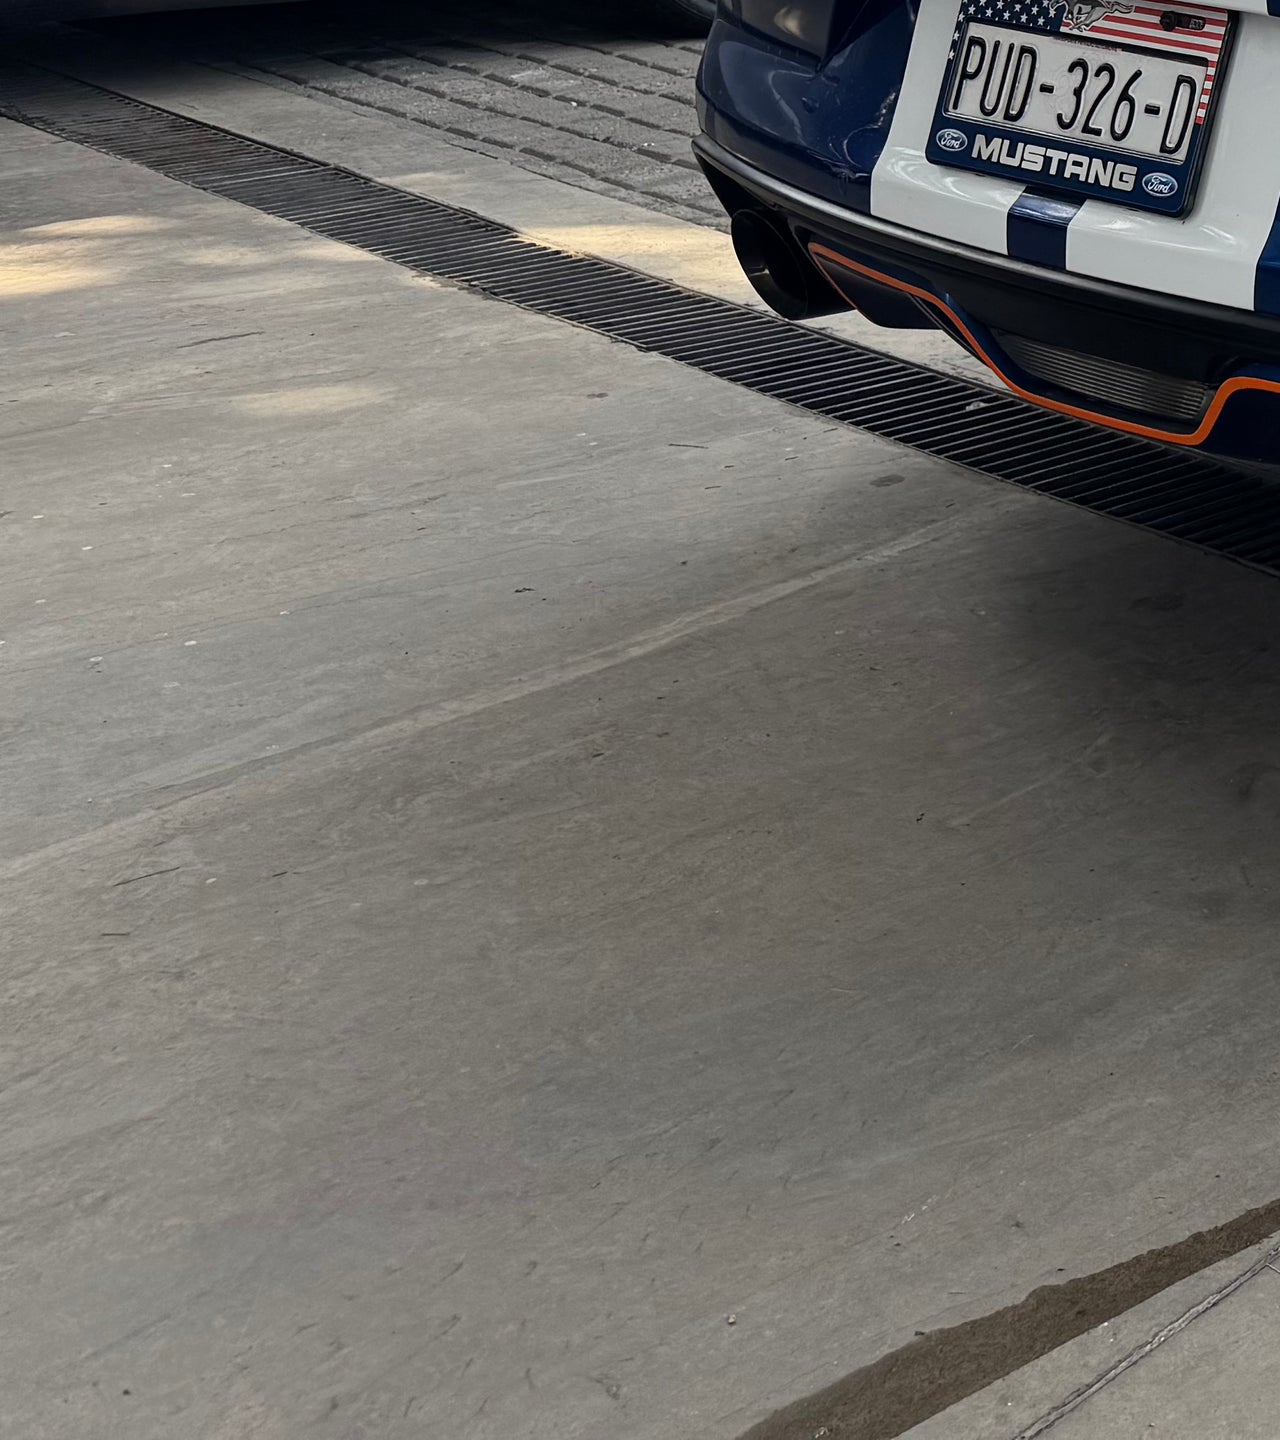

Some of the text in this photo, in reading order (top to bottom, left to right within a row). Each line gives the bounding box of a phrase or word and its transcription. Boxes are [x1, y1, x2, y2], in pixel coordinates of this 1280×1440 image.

[950, 35, 1197, 155] PUD-326-D
[938, 130, 1175, 195] Ford MUSTANG Ford
